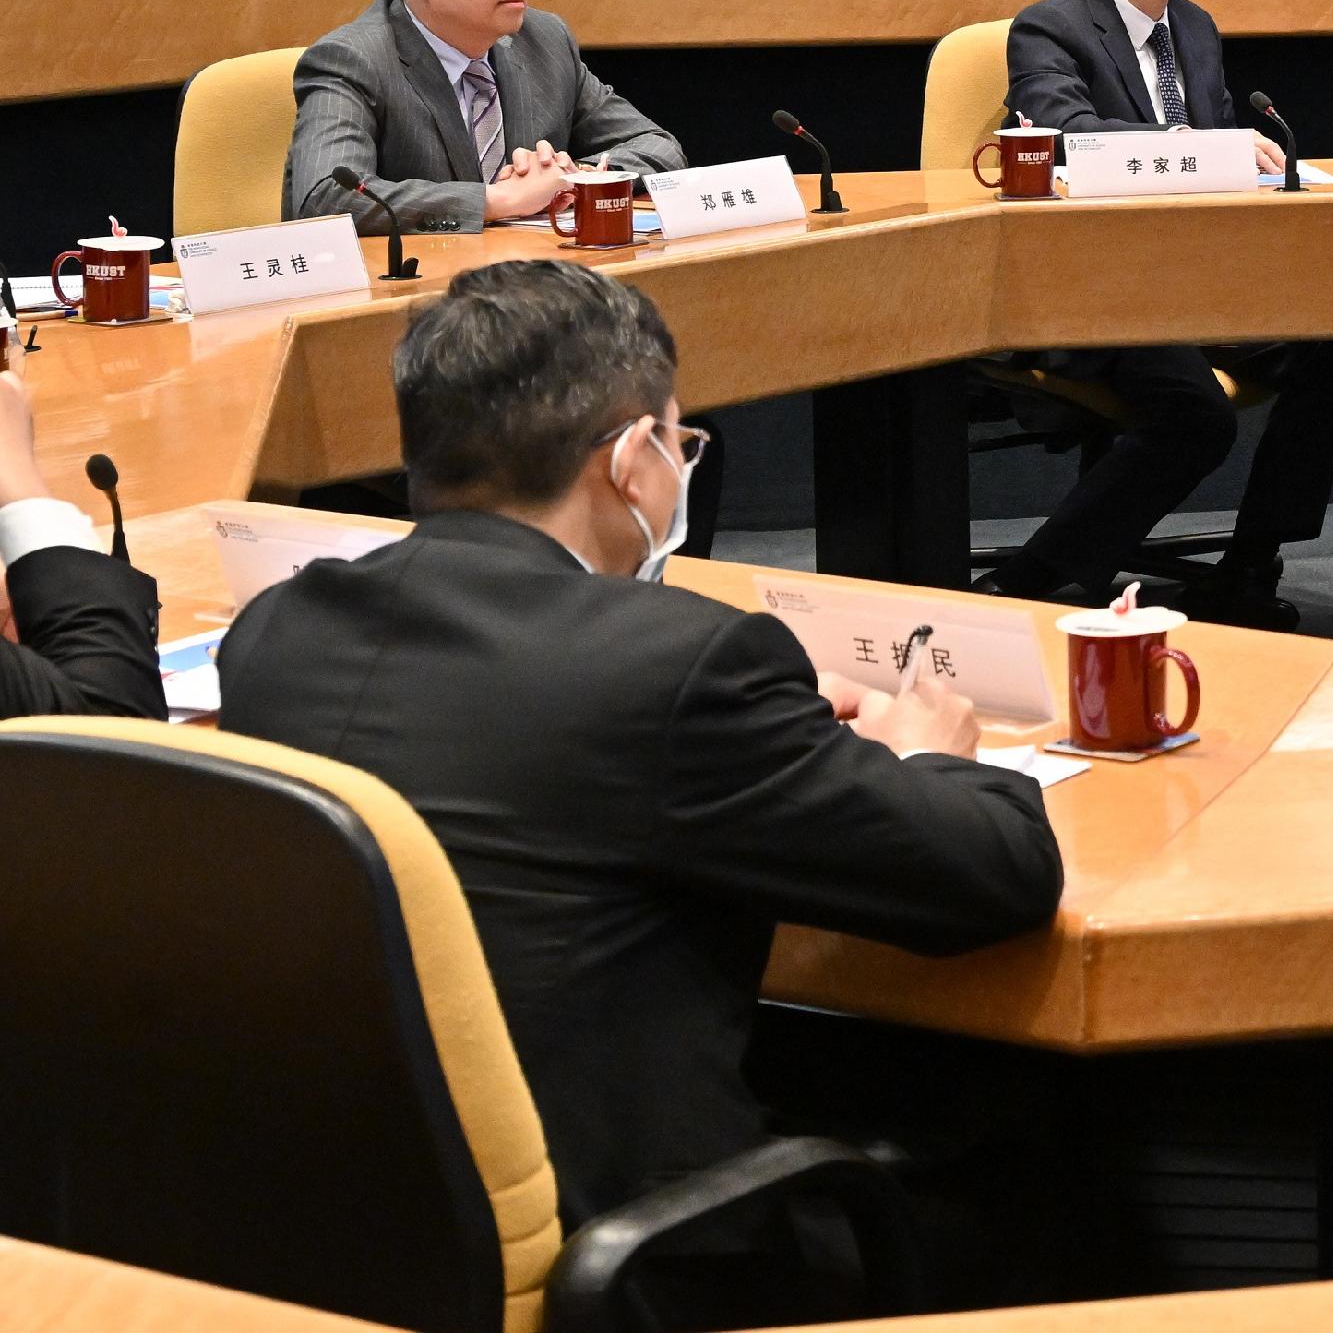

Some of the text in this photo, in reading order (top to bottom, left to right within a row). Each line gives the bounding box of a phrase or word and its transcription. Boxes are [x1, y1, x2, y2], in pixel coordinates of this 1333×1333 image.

[1017, 151, 1050, 162] HKUST
[1127, 155, 1198, 175] 李家超
[595, 196, 631, 210] HKUST
[86, 264, 126, 277] HKUST
[240, 254, 309, 280] 王灵桂
